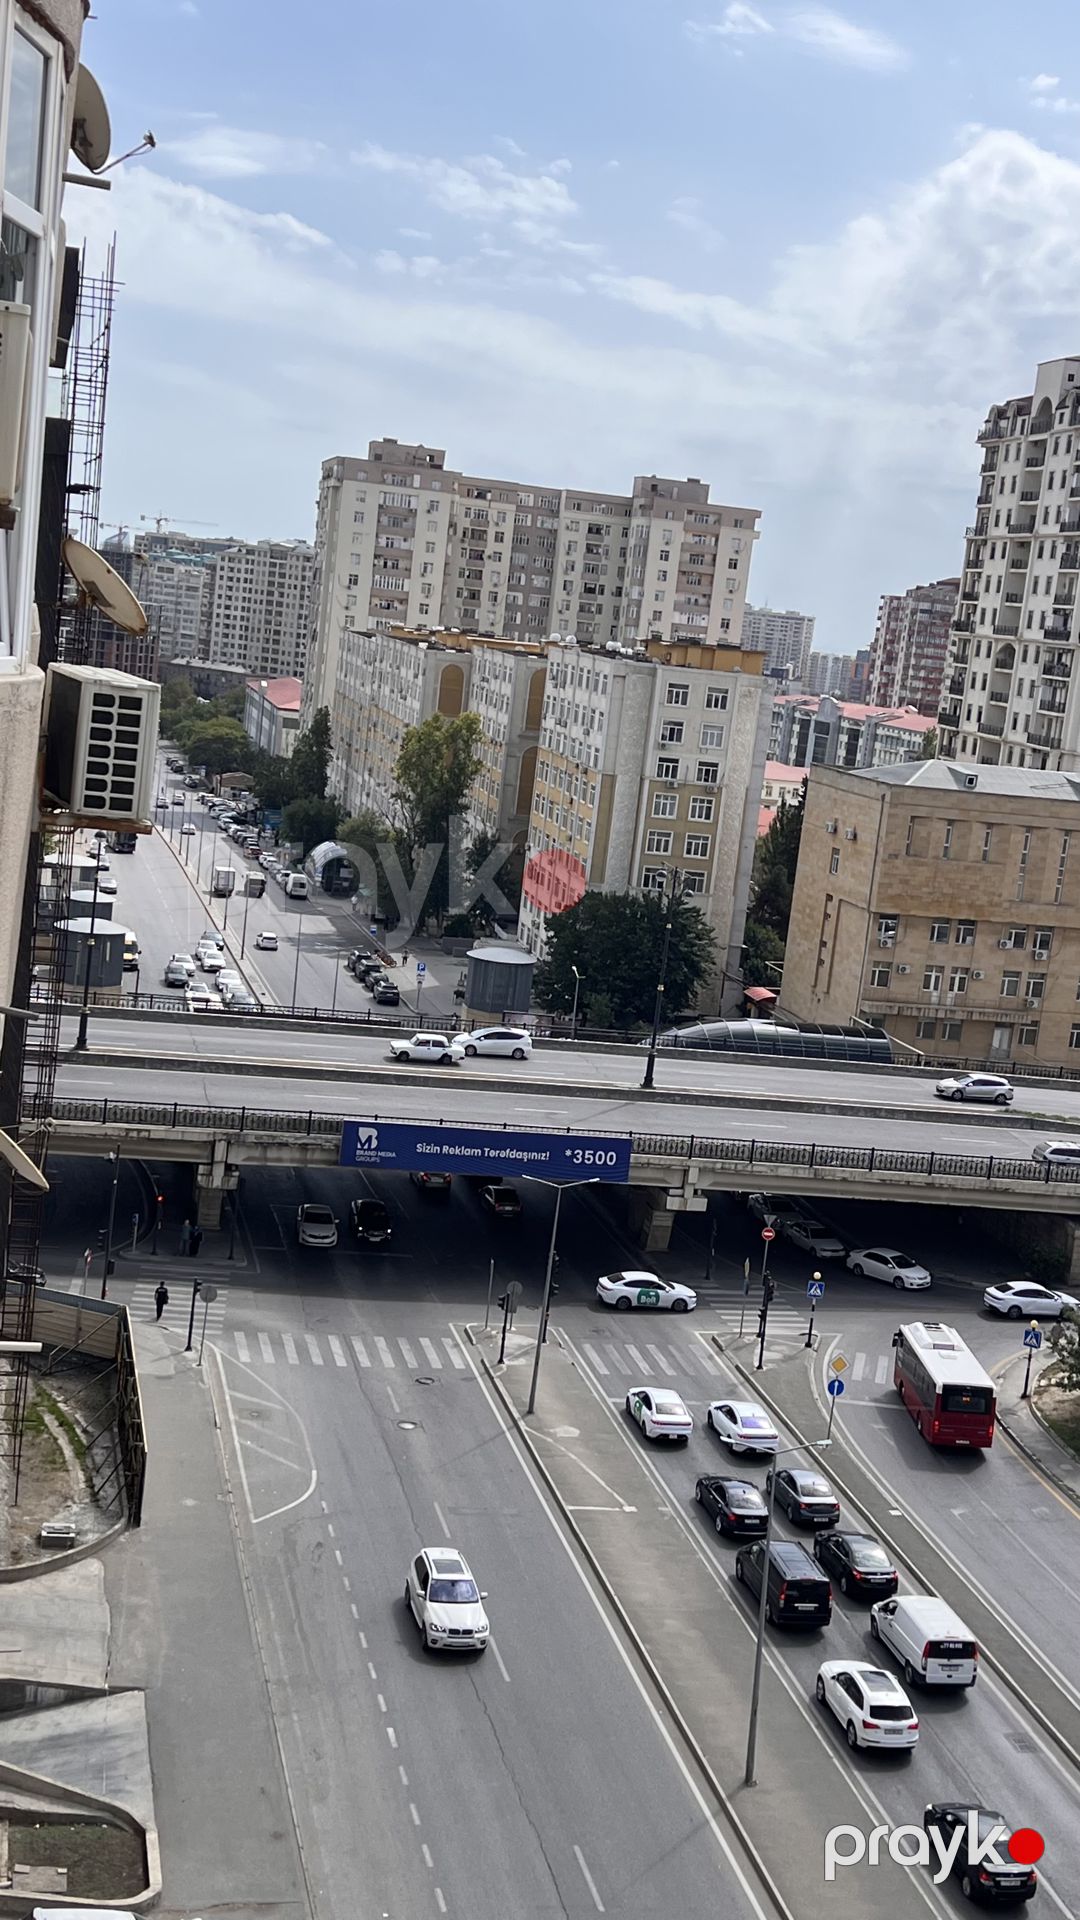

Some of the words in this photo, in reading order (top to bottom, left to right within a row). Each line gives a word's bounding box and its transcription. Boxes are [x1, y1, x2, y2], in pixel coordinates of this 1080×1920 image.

[416, 1142, 440, 1154] Sizin
[442, 1144, 482, 1157] Reklam
[640, 1295, 657, 1304] Bolt
